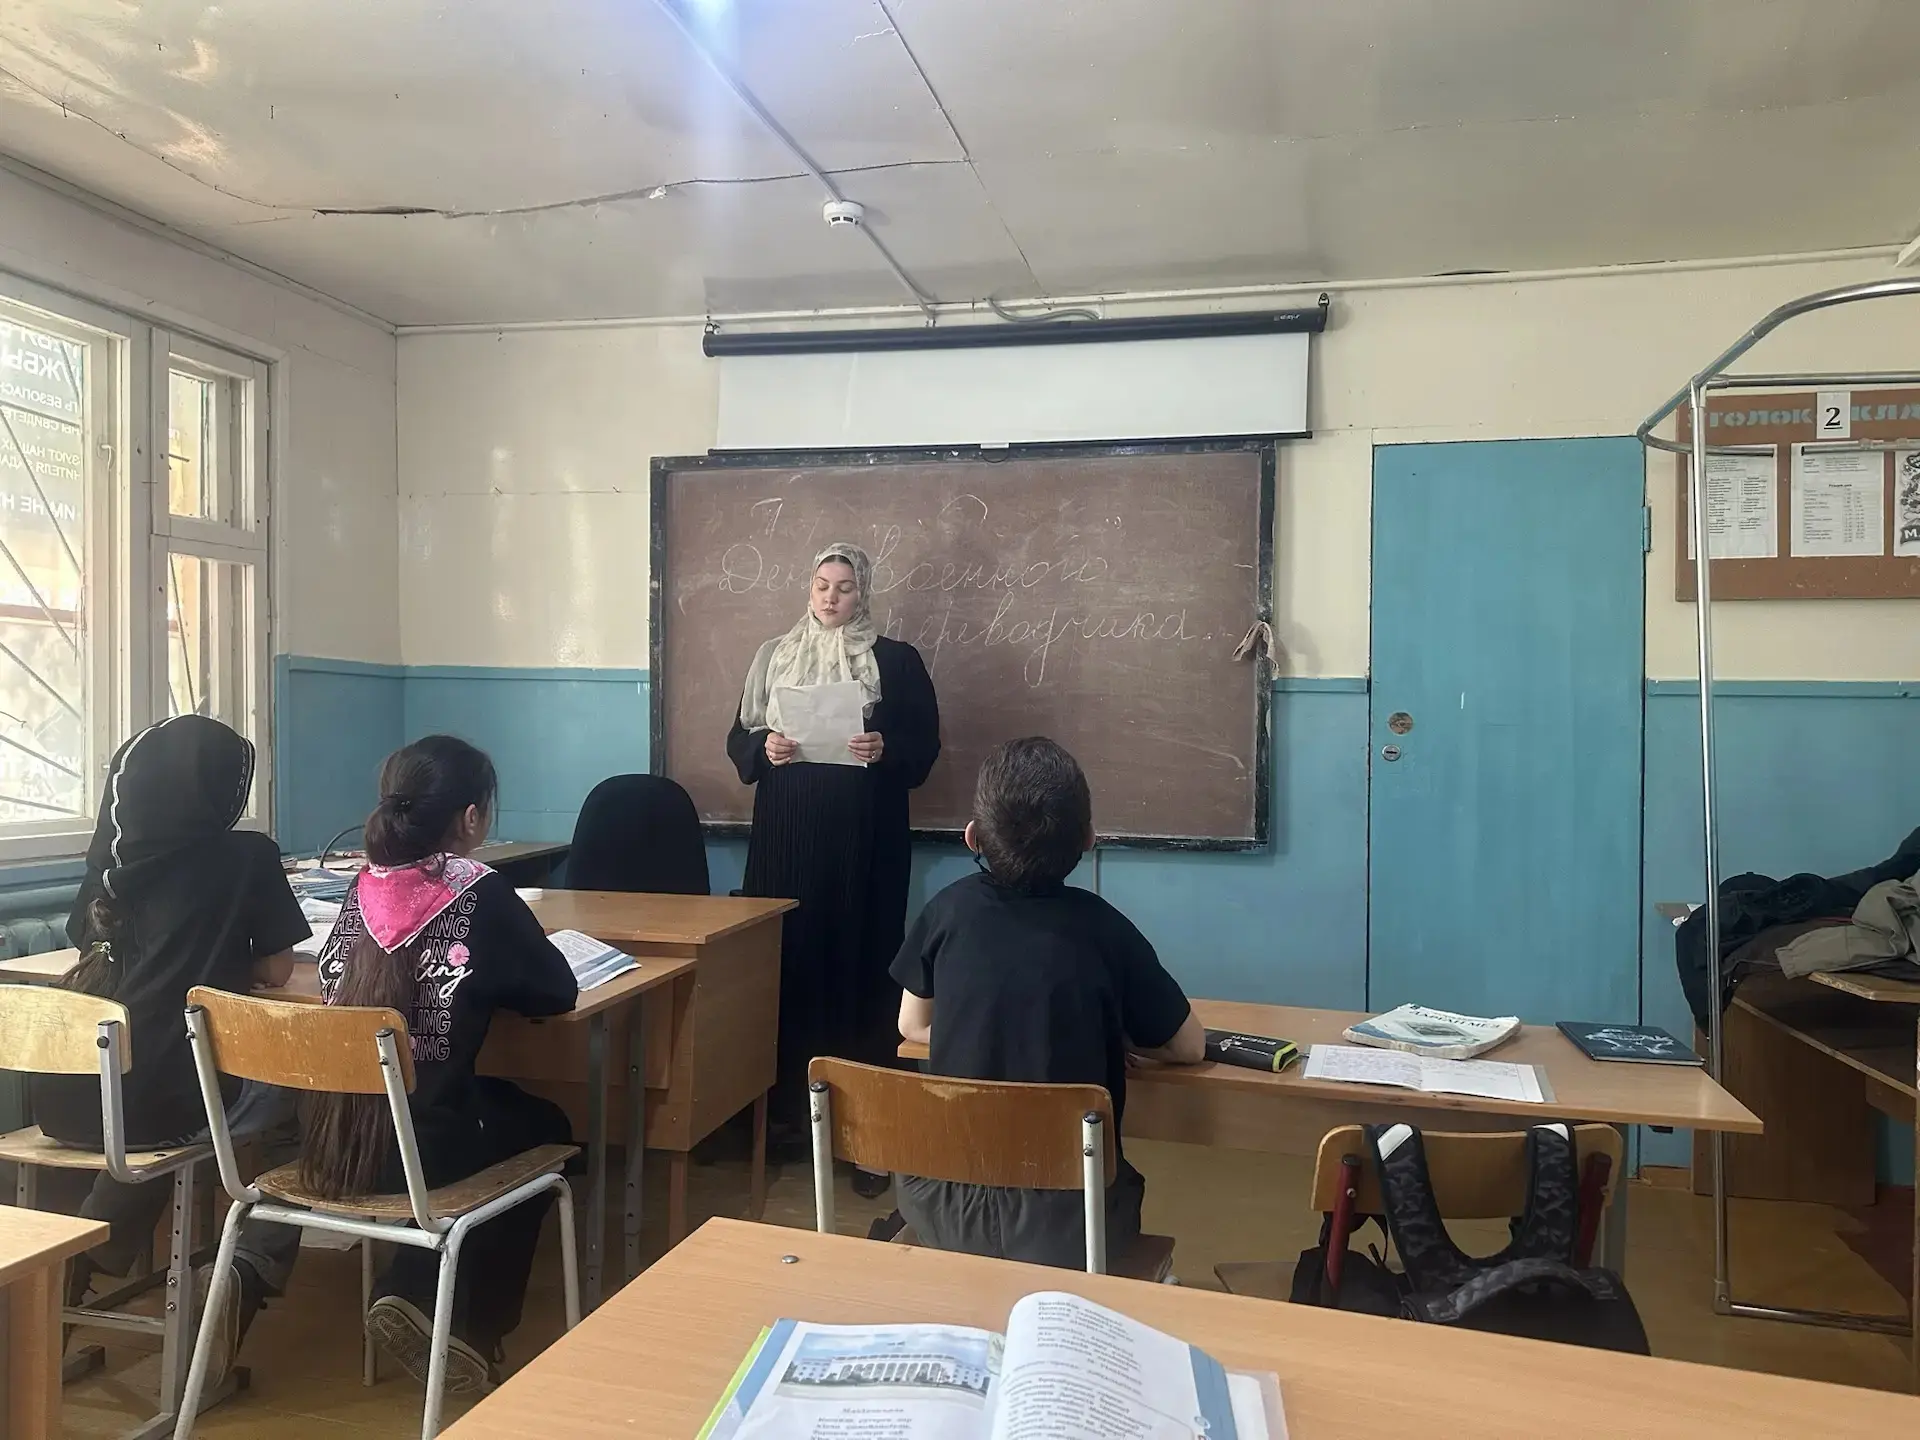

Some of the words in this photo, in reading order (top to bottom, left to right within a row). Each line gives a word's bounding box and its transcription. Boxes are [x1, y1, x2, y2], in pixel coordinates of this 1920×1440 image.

[1688, 408, 1813, 428] ГОЛОК
[1823, 406, 1844, 429] 2
[718, 543, 811, 594] Ден
[408, 1009, 452, 1035] LING
